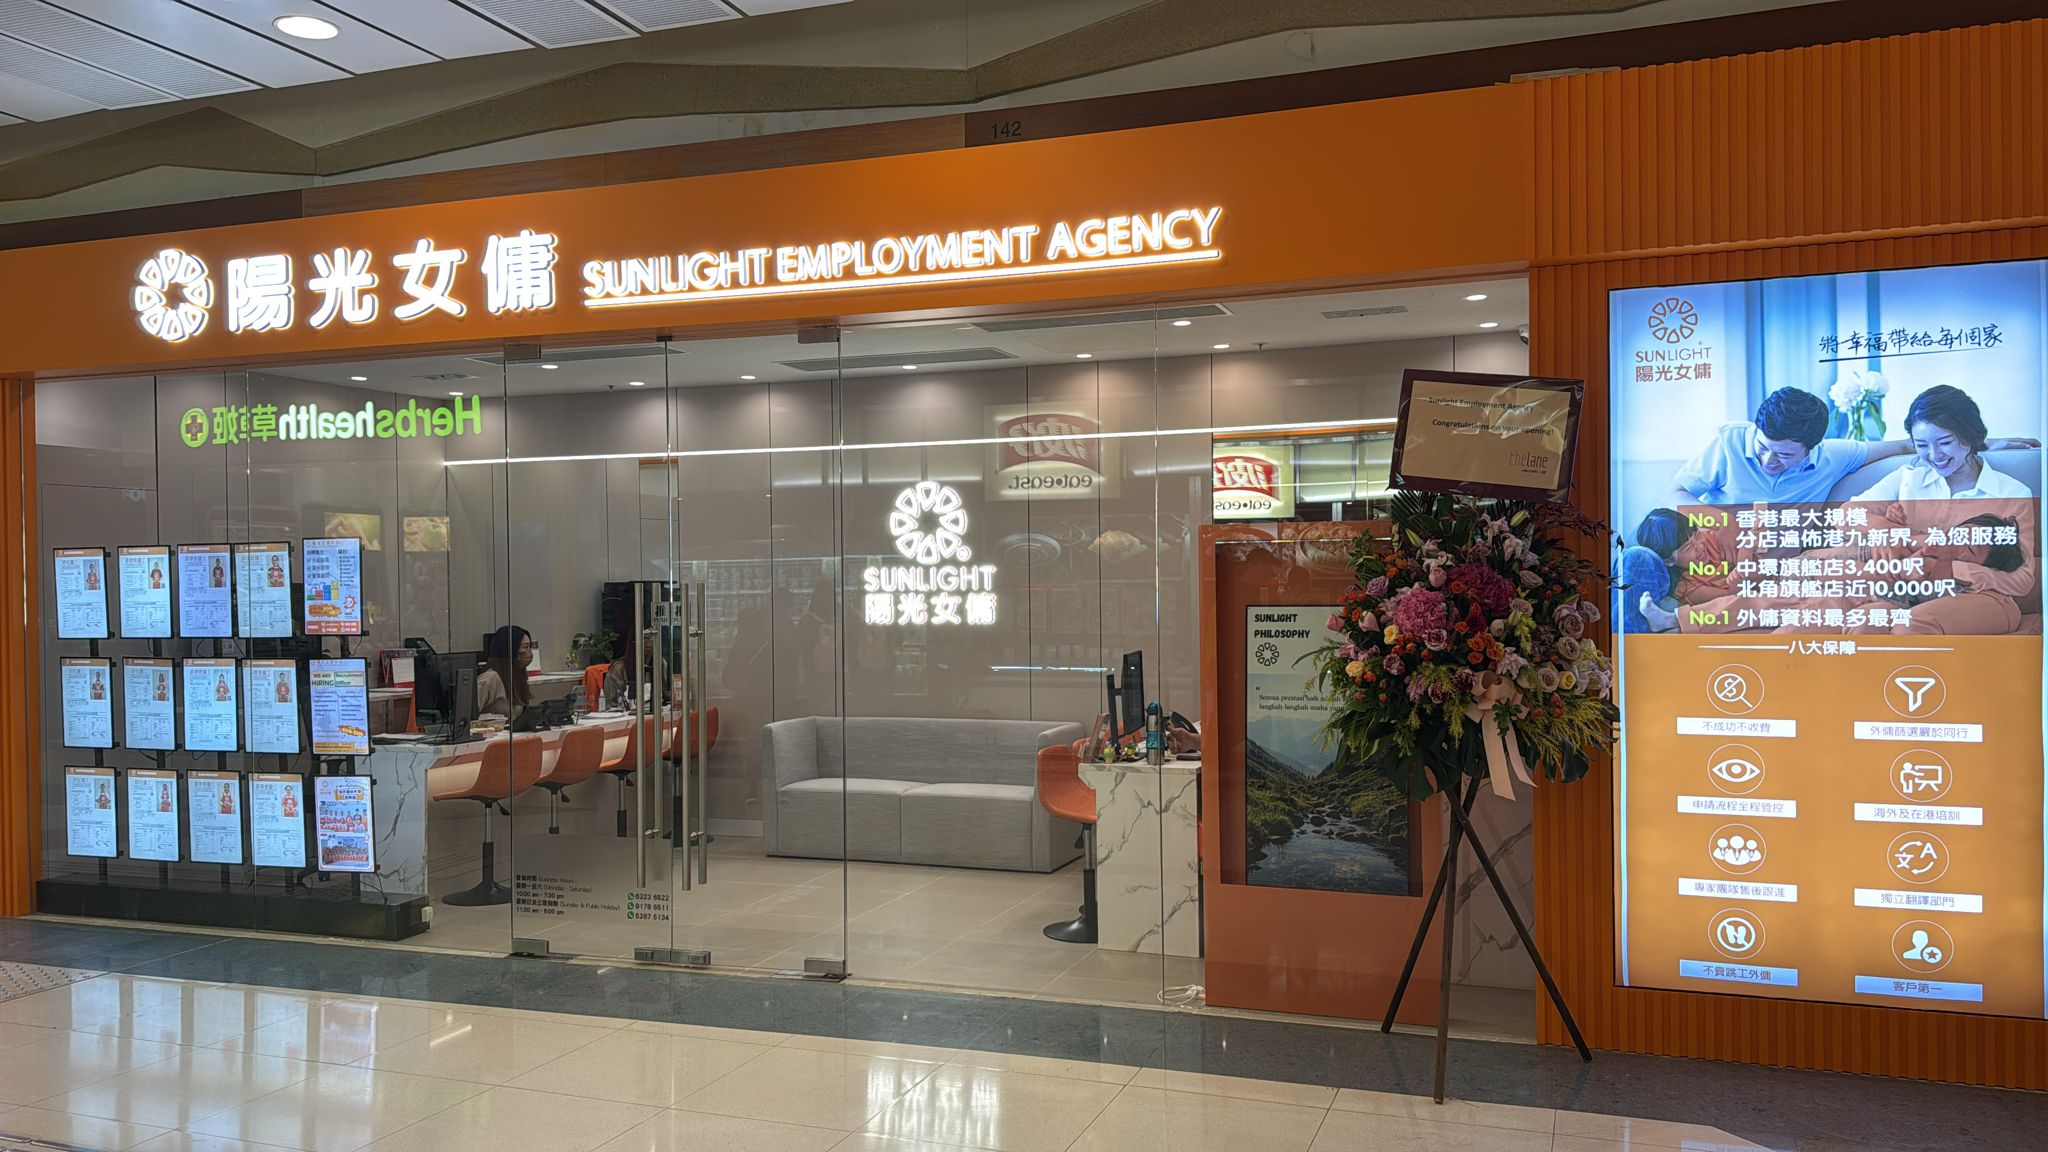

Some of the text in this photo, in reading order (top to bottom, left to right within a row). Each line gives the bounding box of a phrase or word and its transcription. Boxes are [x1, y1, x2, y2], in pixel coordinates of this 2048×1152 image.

[990, 120, 1022, 139] 142
[582, 206, 1223, 298] SUNLIGHT EMPLOYMENT AGENCY
[226, 229, 559, 334] 陽光女傭
[1818, 323, 2003, 355] 將幸福帶給每個家
[1635, 347, 1712, 363] SUNLIGHT
[1635, 362, 1712, 383] 陽光女傭
[1428, 397, 1458, 406] Sunlight
[1459, 399, 1506, 410] Employment
[1432, 419, 1490, 431] Congratulations
[1688, 508, 1869, 528] No.1 香港最大規模
[1923, 525, 2018, 546] 為您服務
[1688, 557, 1924, 578] No.1 中環旗艦店3,400呎
[863, 565, 998, 591] SUNLIGHT
[1736, 578, 1956, 599] 北角旗艦店近10,000呎
[655, 604, 667, 617] 推
[864, 591, 998, 625] 陽光女傭
[1254, 613, 1298, 623] SUNLIGHT
[1688, 608, 1912, 628] No.1 外傭資料最多最齊
[1253, 629, 1311, 639] PHILOSOPHY
[1788, 639, 1857, 656] 八大保障
[1259, 703, 1283, 711] langkah
[1284, 703, 1309, 711] langkah
[1702, 721, 1771, 733] 不成功不收費
[1869, 725, 1969, 739] 外傭篩選嚴於同行
[1692, 799, 1785, 814] 申請流程全程管控
[1873, 807, 1960, 821] 海外及在港培訓
[1694, 882, 1786, 898] 專家團隊售後跟進
[1880, 893, 1955, 908] 獨立翻譯部門
[1893, 981, 1943, 994] 客戶第一
